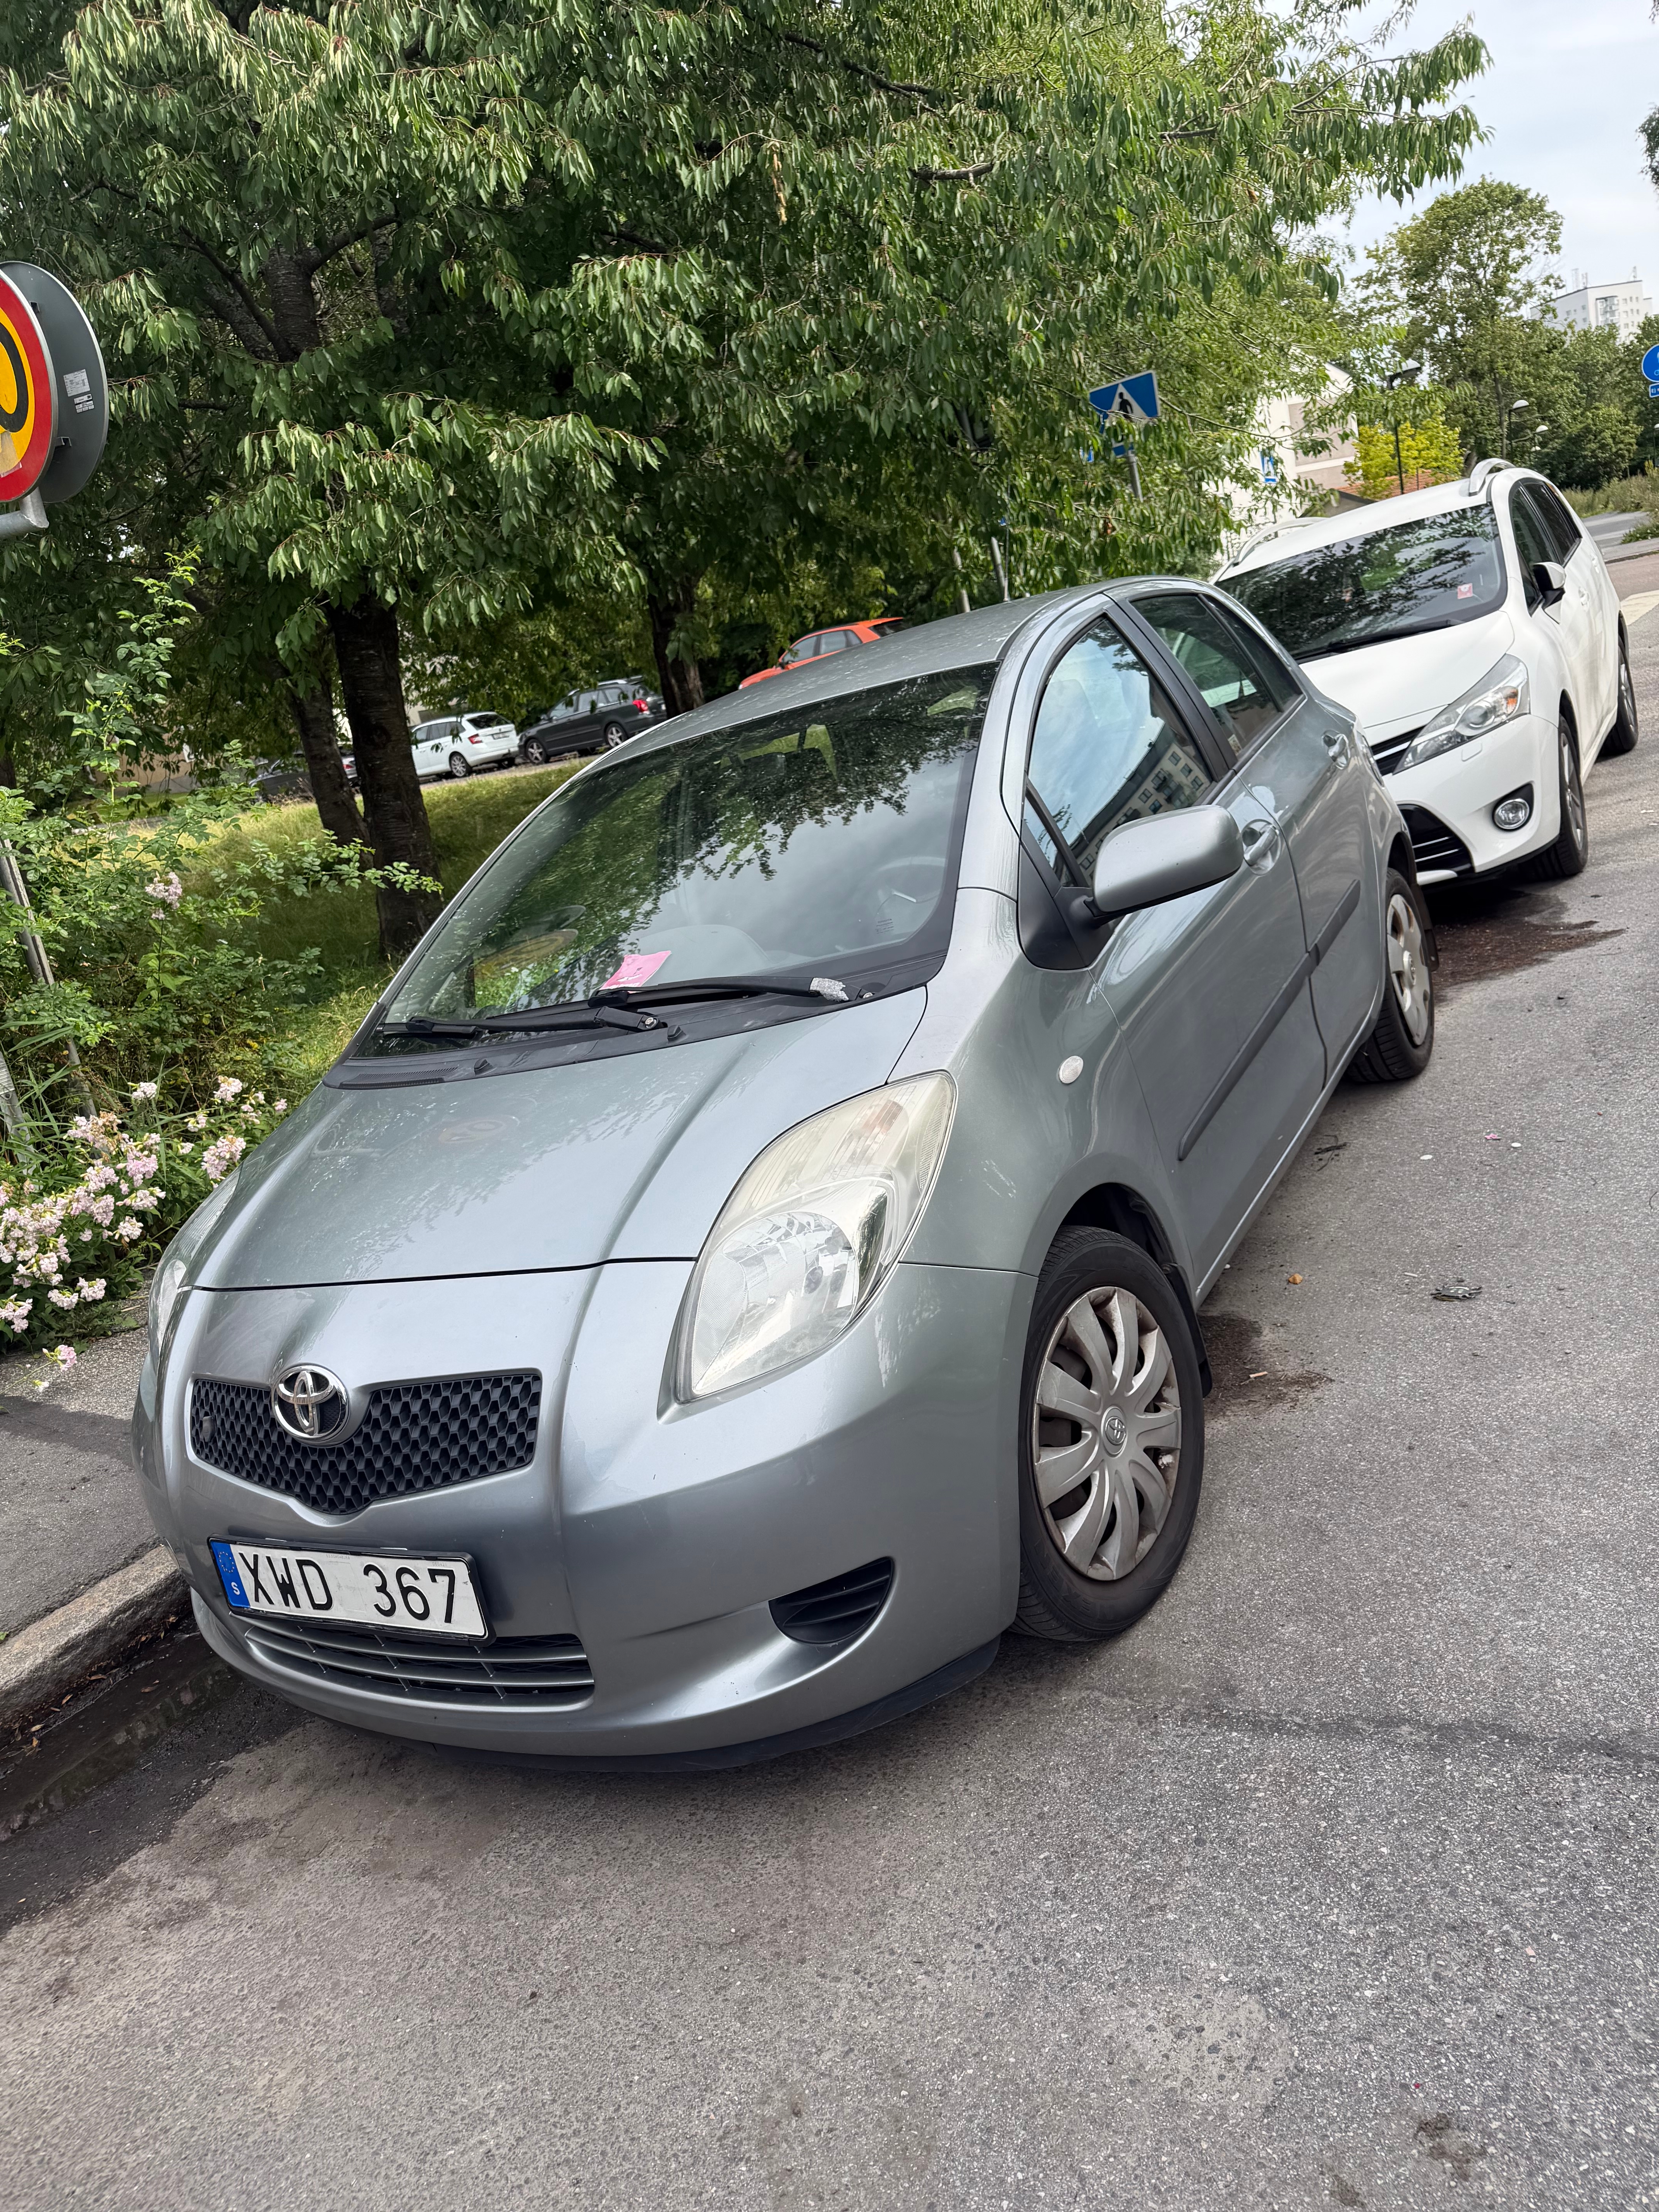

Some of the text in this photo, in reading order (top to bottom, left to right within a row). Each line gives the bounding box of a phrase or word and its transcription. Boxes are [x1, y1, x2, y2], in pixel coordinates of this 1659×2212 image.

[231, 1582, 240, 1595] S
[239, 1552, 455, 1623] XWD 367
